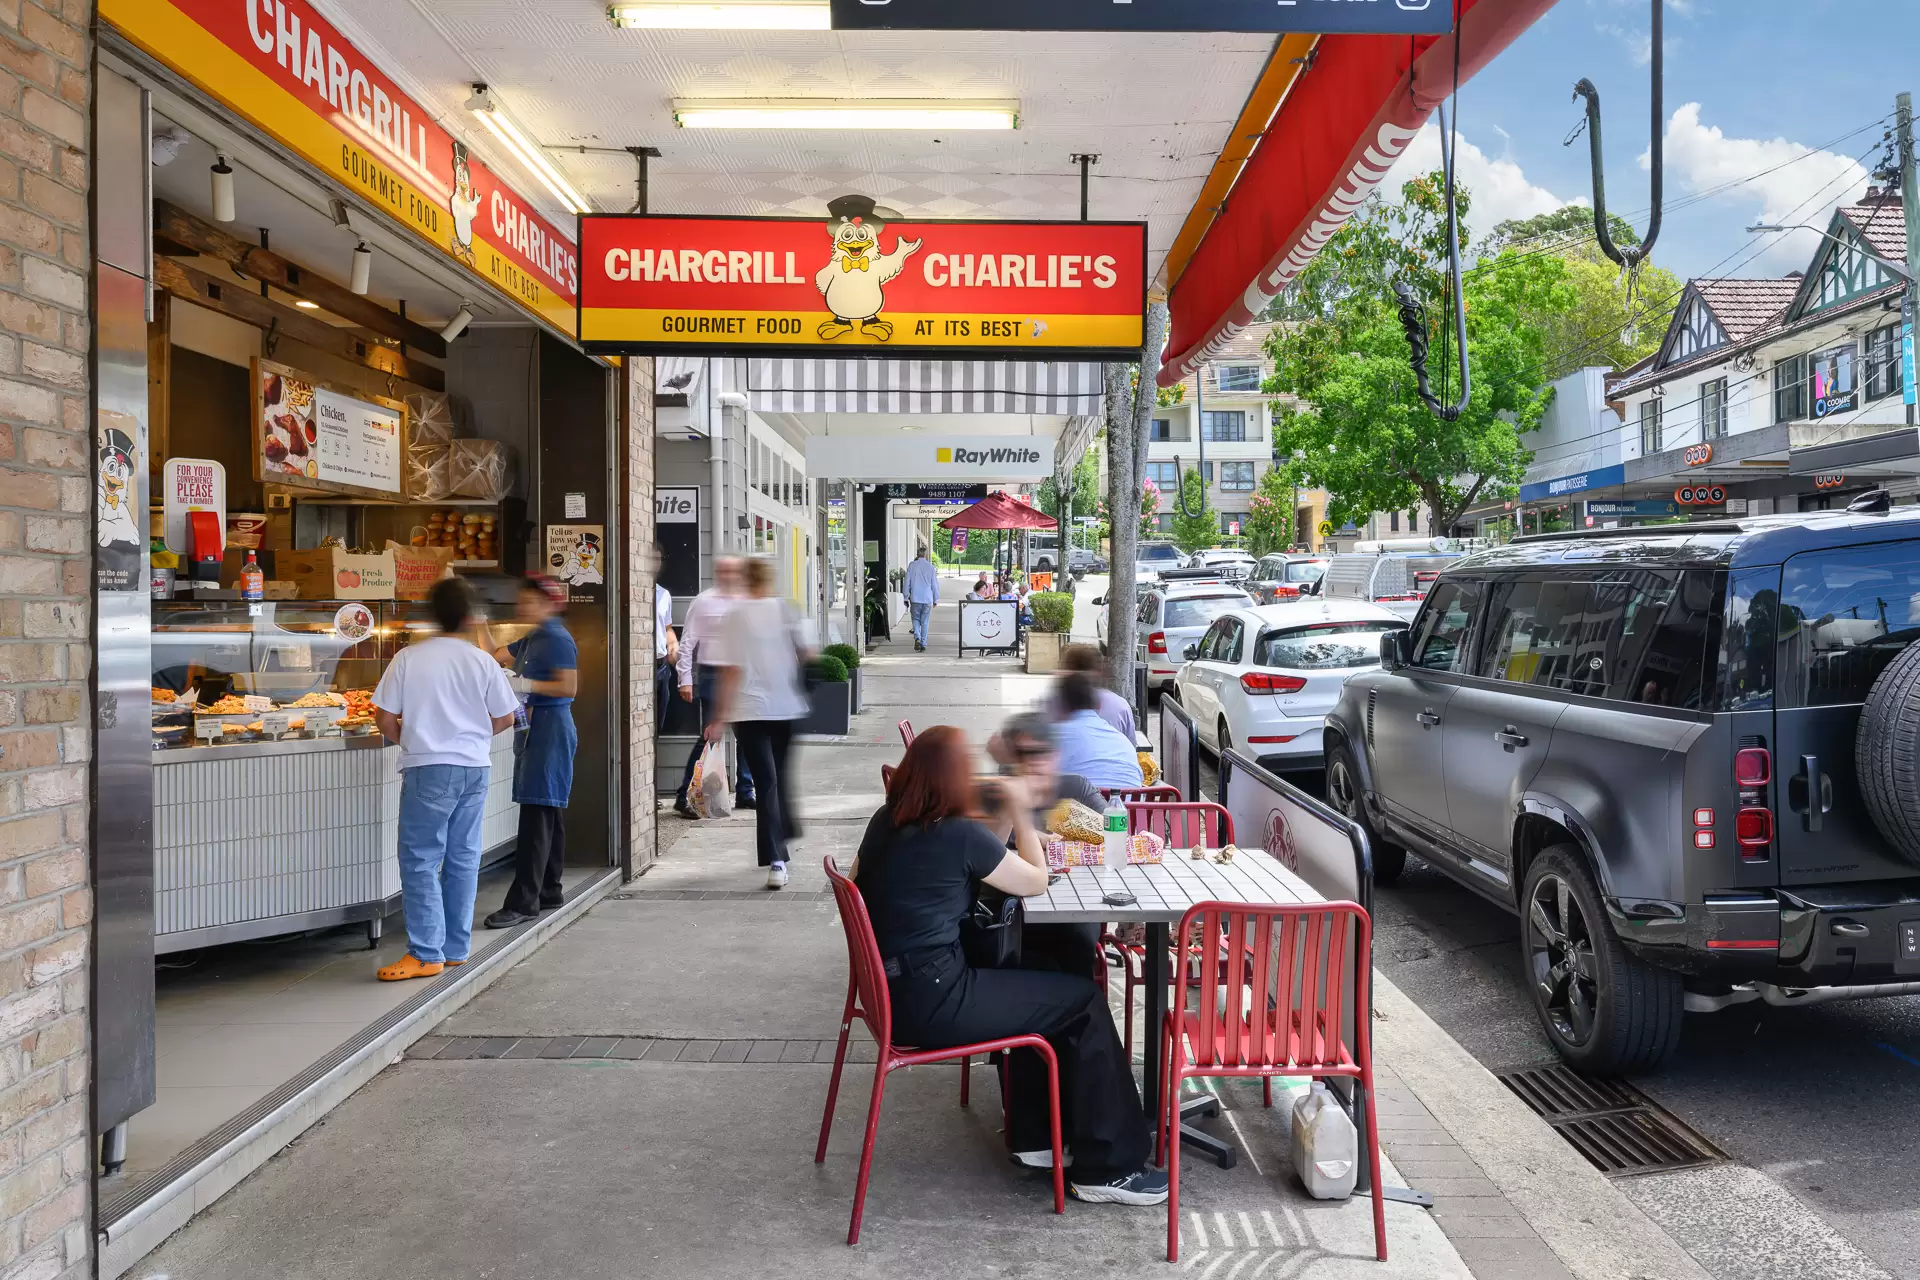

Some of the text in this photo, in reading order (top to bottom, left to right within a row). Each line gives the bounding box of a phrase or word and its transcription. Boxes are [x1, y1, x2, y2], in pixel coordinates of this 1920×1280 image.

[246, 0, 434, 183] CHARGRILL
[342, 143, 437, 233] GOURMET FOOD
[491, 189, 577, 295] CHARLIE'S
[491, 254, 539, 304] AT ITS BEST
[604, 248, 1117, 289] CHARGRILL CHARLIE'S
[662, 316, 1022, 337] GOURMET FOOD AT ITS BEST
[320, 404, 346, 422] Chicken.
[176, 465, 213, 476] FOR YOUR
[176, 475, 213, 485] CONVENIENCE
[177, 484, 213, 498] PLEASE
[1590, 504, 1616, 513] BONJOUR
[362, 568, 382, 576] Fresh
[1907, 928, 1916, 952] NSW
